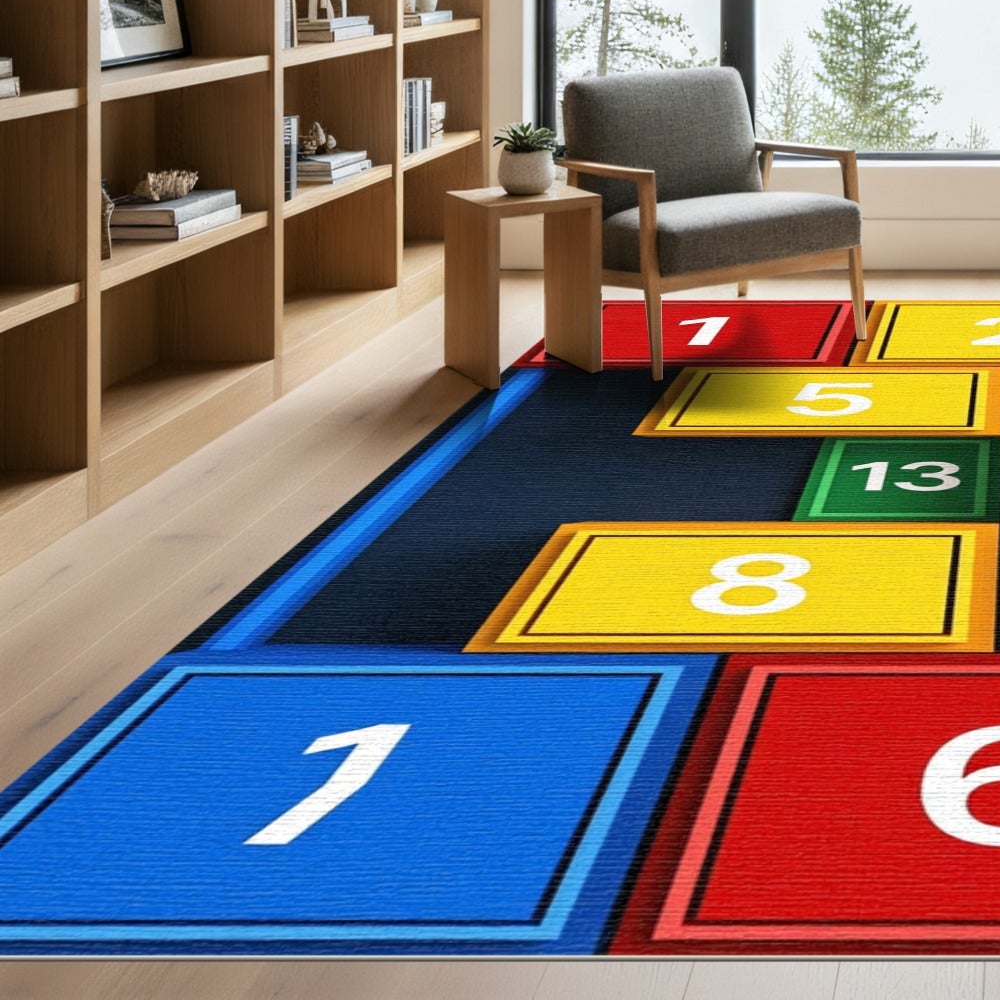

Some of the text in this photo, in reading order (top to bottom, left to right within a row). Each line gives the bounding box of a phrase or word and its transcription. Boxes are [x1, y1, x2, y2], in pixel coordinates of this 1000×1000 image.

[679, 316, 730, 346] 1
[786, 382, 874, 417] 5
[851, 461, 961, 493] 13
[690, 553, 811, 617] 8
[243, 723, 411, 846] 1
